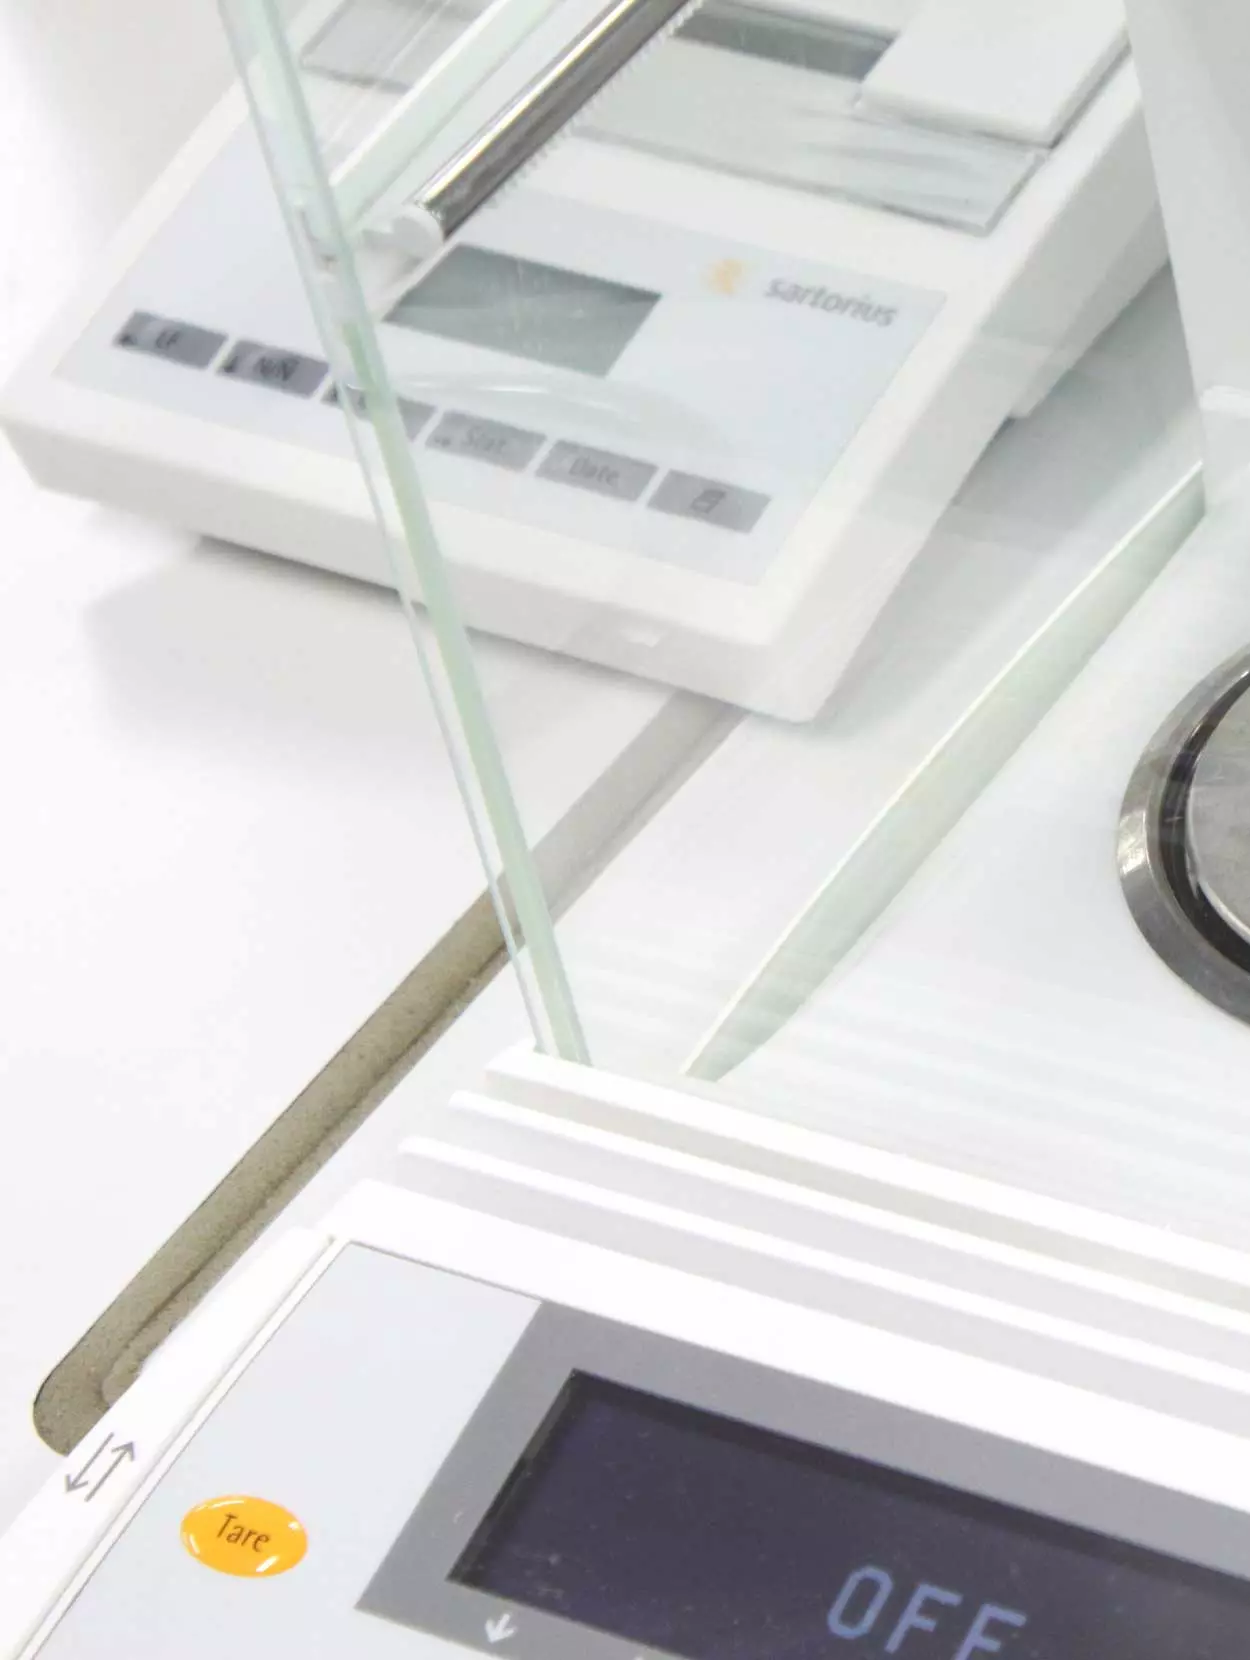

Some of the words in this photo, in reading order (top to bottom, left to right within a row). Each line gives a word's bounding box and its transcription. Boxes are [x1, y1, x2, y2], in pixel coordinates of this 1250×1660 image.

[763, 278, 898, 327] sartorius
[216, 1513, 271, 1553] Tare
[826, 1565, 1027, 1660] OFF
